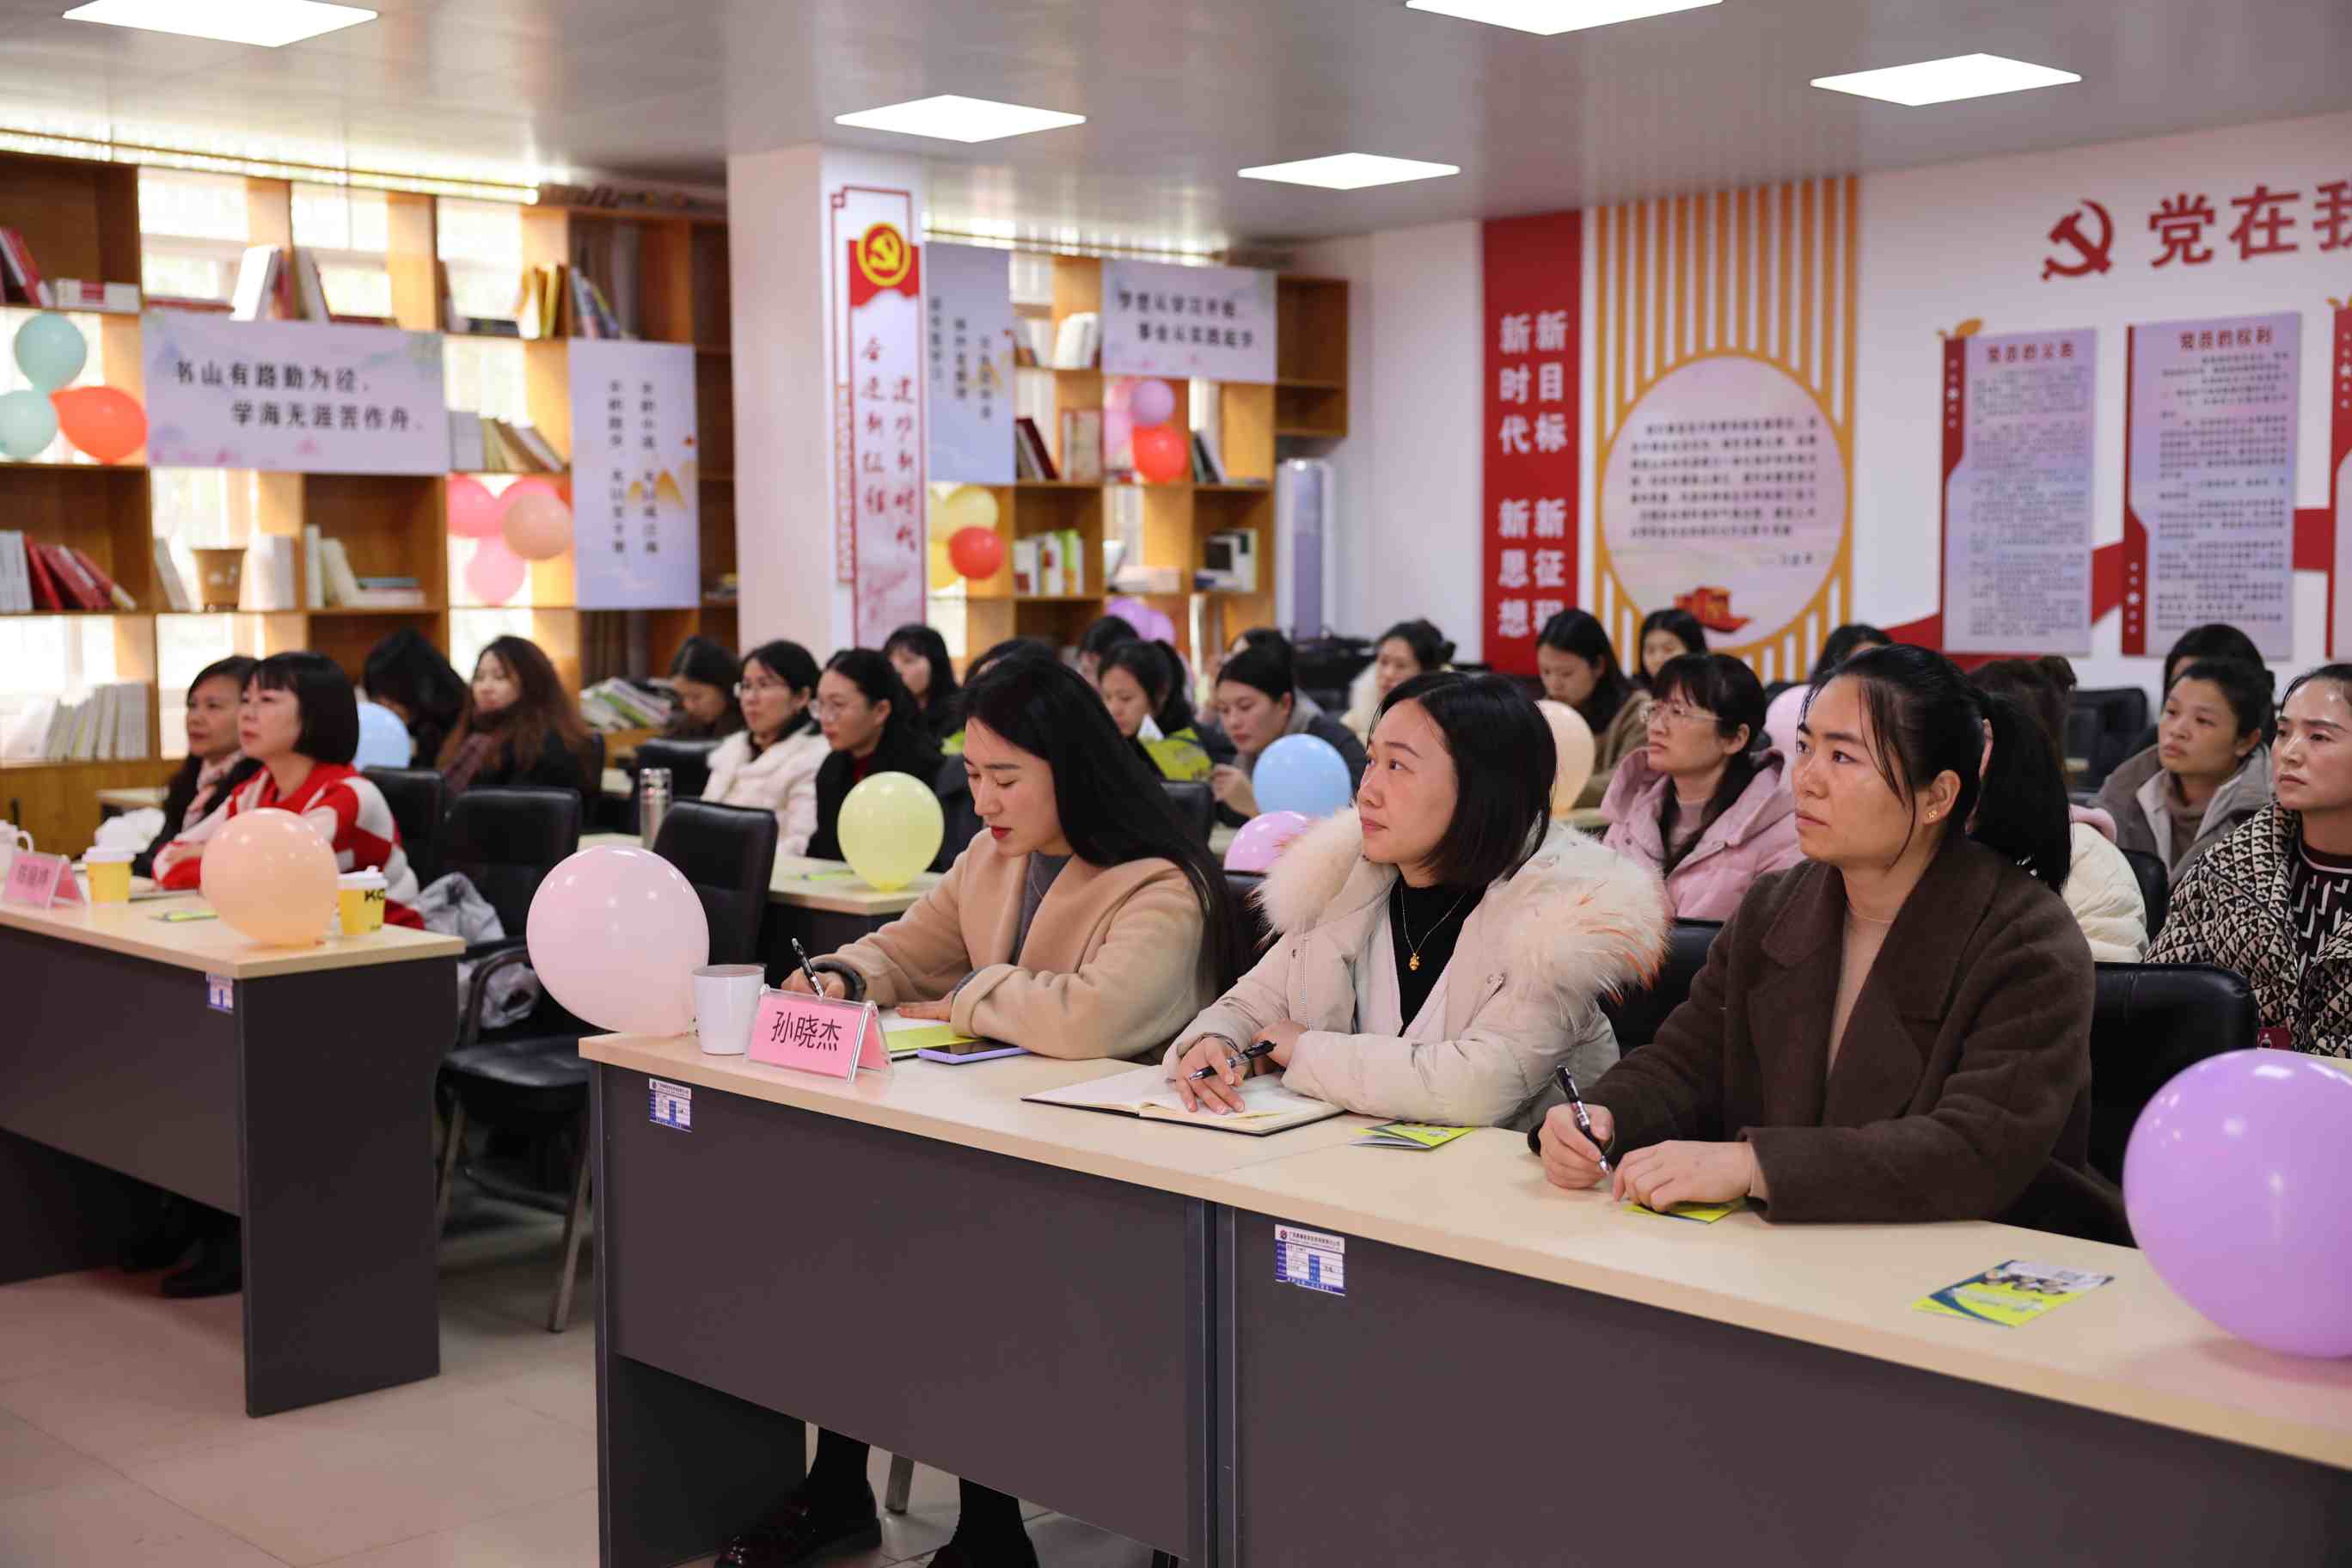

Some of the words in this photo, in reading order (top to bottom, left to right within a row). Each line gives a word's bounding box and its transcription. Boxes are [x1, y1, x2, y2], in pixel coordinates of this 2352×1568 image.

[1498, 314, 1532, 456] 新时代
[1534, 310, 1570, 454] 新目标
[1498, 497, 1530, 639] 新思想
[772, 1010, 842, 1052] 孙晓杰
